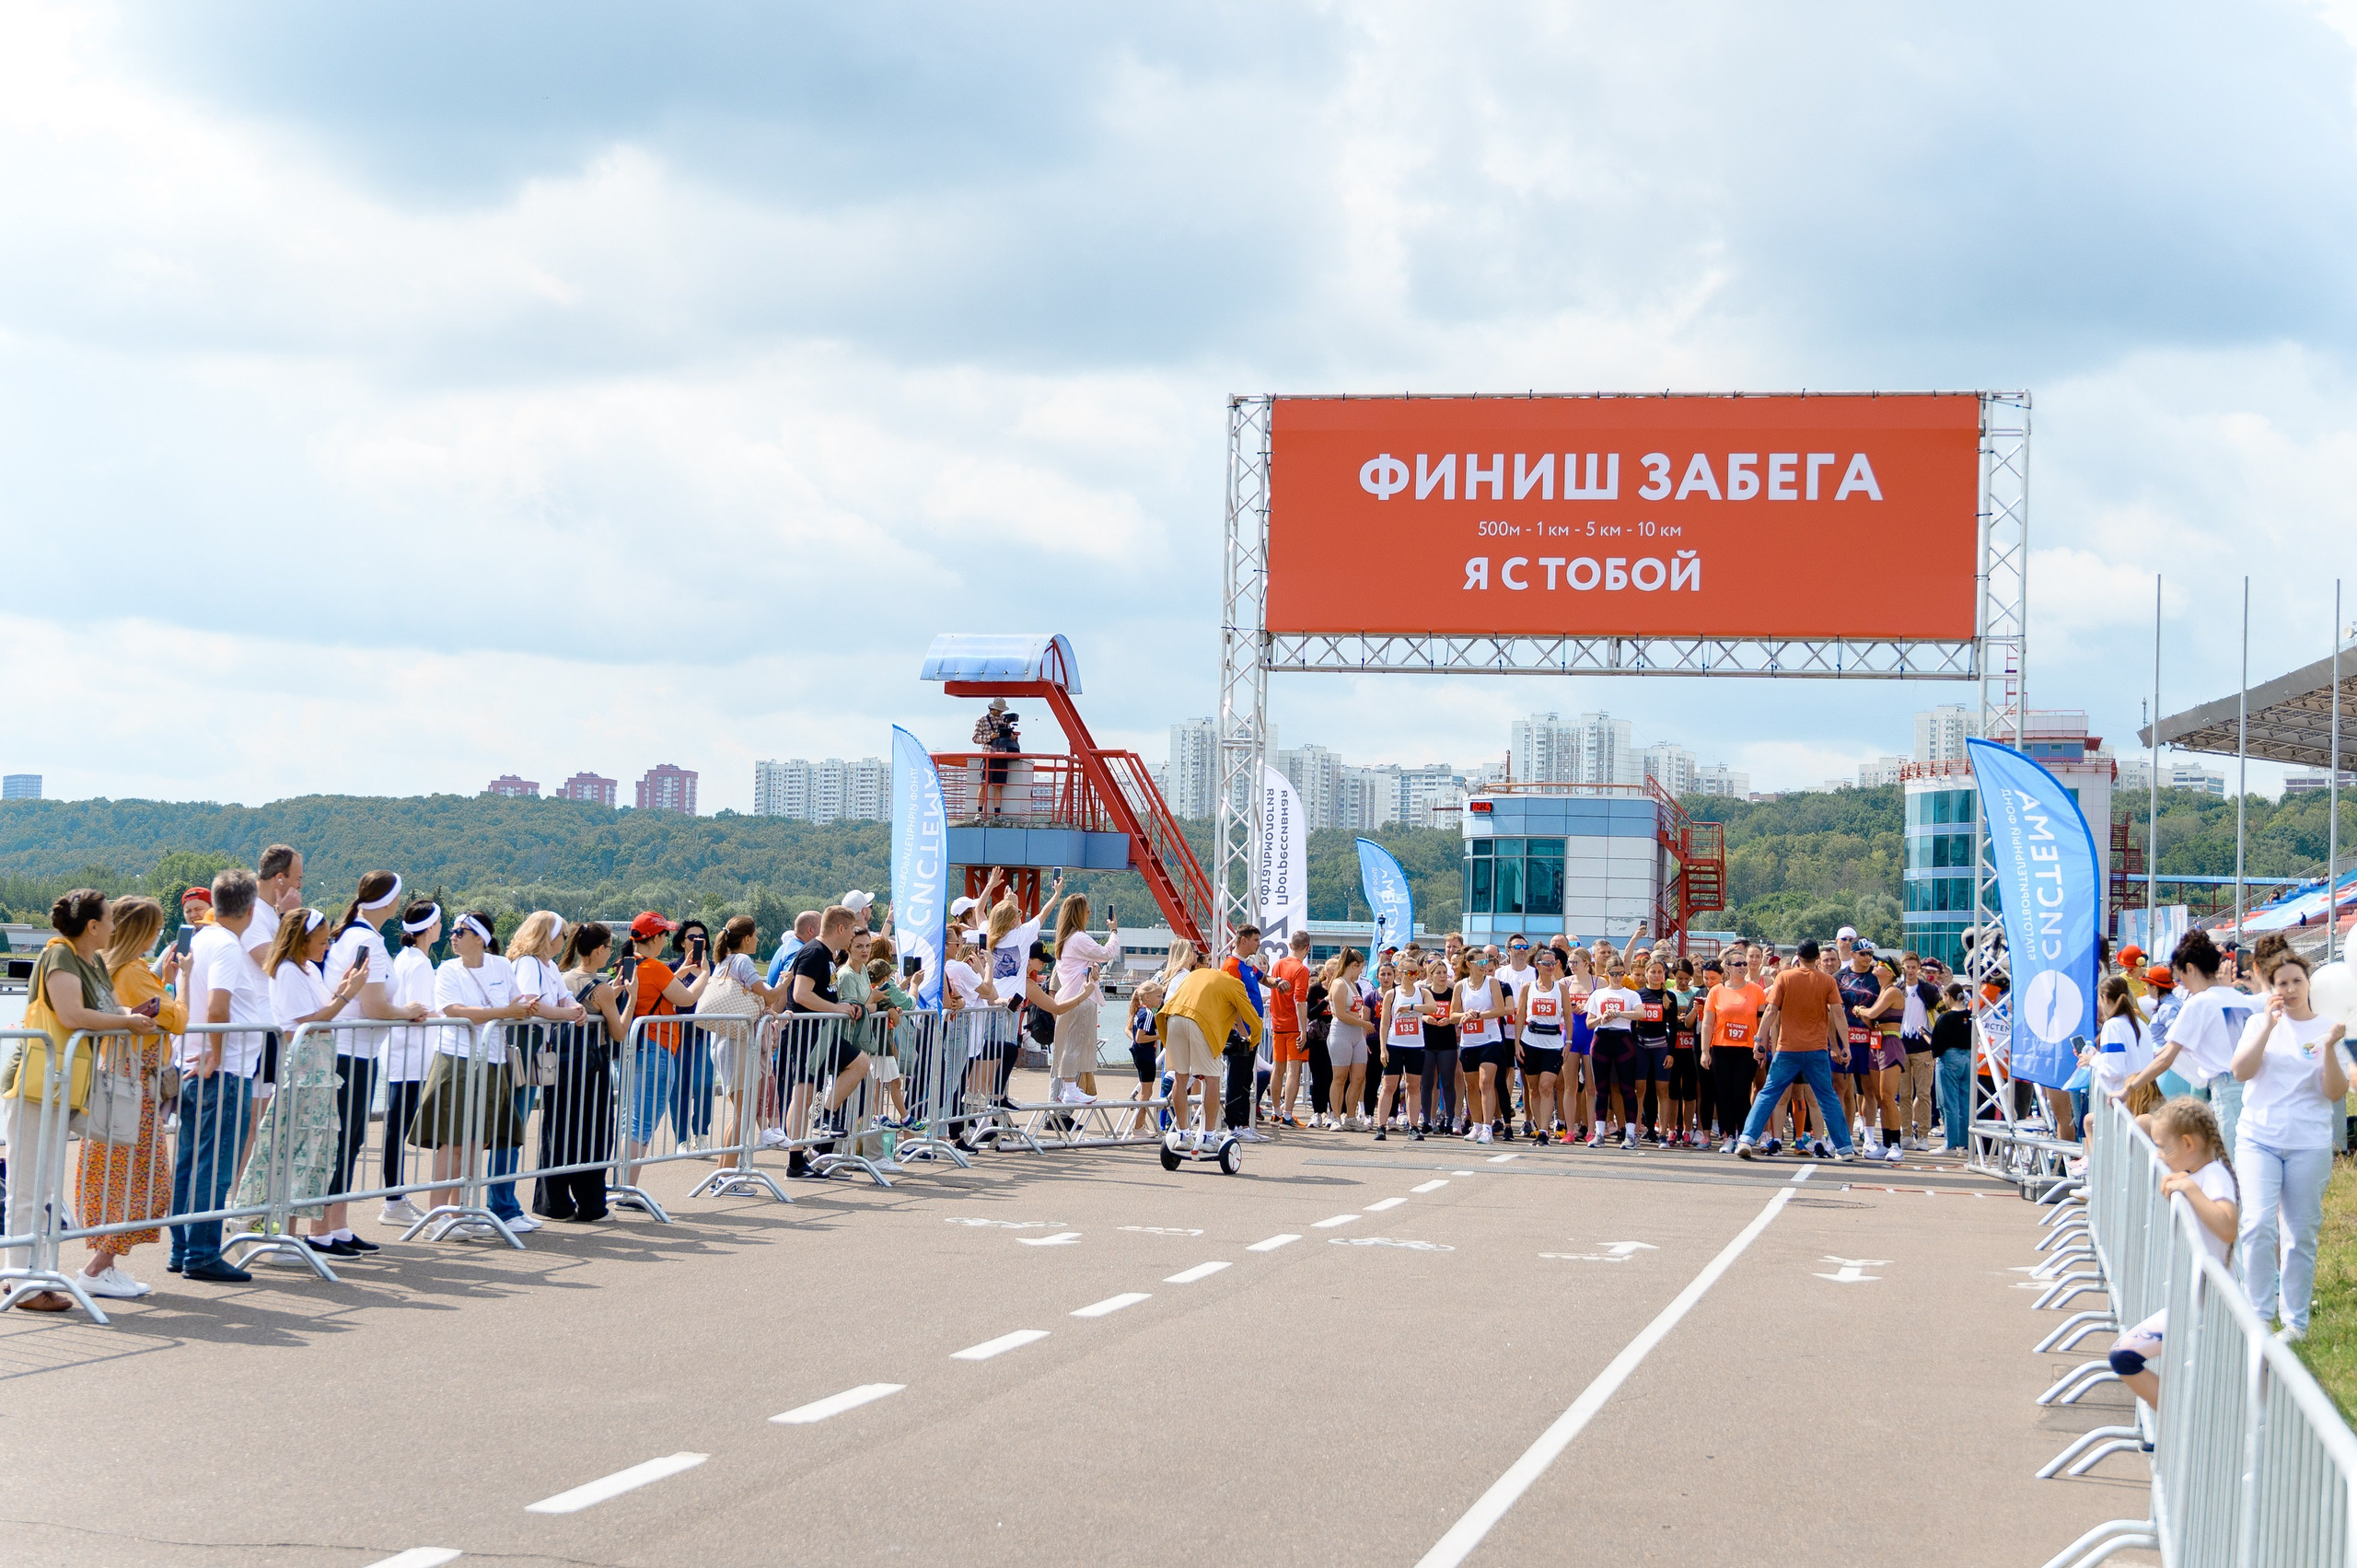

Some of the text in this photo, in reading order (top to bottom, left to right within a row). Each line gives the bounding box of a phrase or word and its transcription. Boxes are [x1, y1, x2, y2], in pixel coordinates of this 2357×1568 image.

[1359, 452, 1884, 501] ФИНИШ ЗАБЕГА
[1478, 520, 1520, 537] 500м
[1537, 521, 1543, 536] 1
[1549, 526, 1569, 537] км
[1585, 521, 1596, 537] 5
[1600, 526, 1621, 537] км
[1638, 521, 1655, 537] 10
[1660, 526, 1681, 537] км
[1462, 550, 1701, 592] Я С ТОБОЙ
[1435, 1006, 1446, 1016] 72
[1537, 1004, 1551, 1013] 195
[1399, 1023, 1414, 1033] 135
[1466, 1022, 1478, 1030] 151
[1728, 1028, 1744, 1039] 197
[1679, 1037, 1694, 1045] 162
